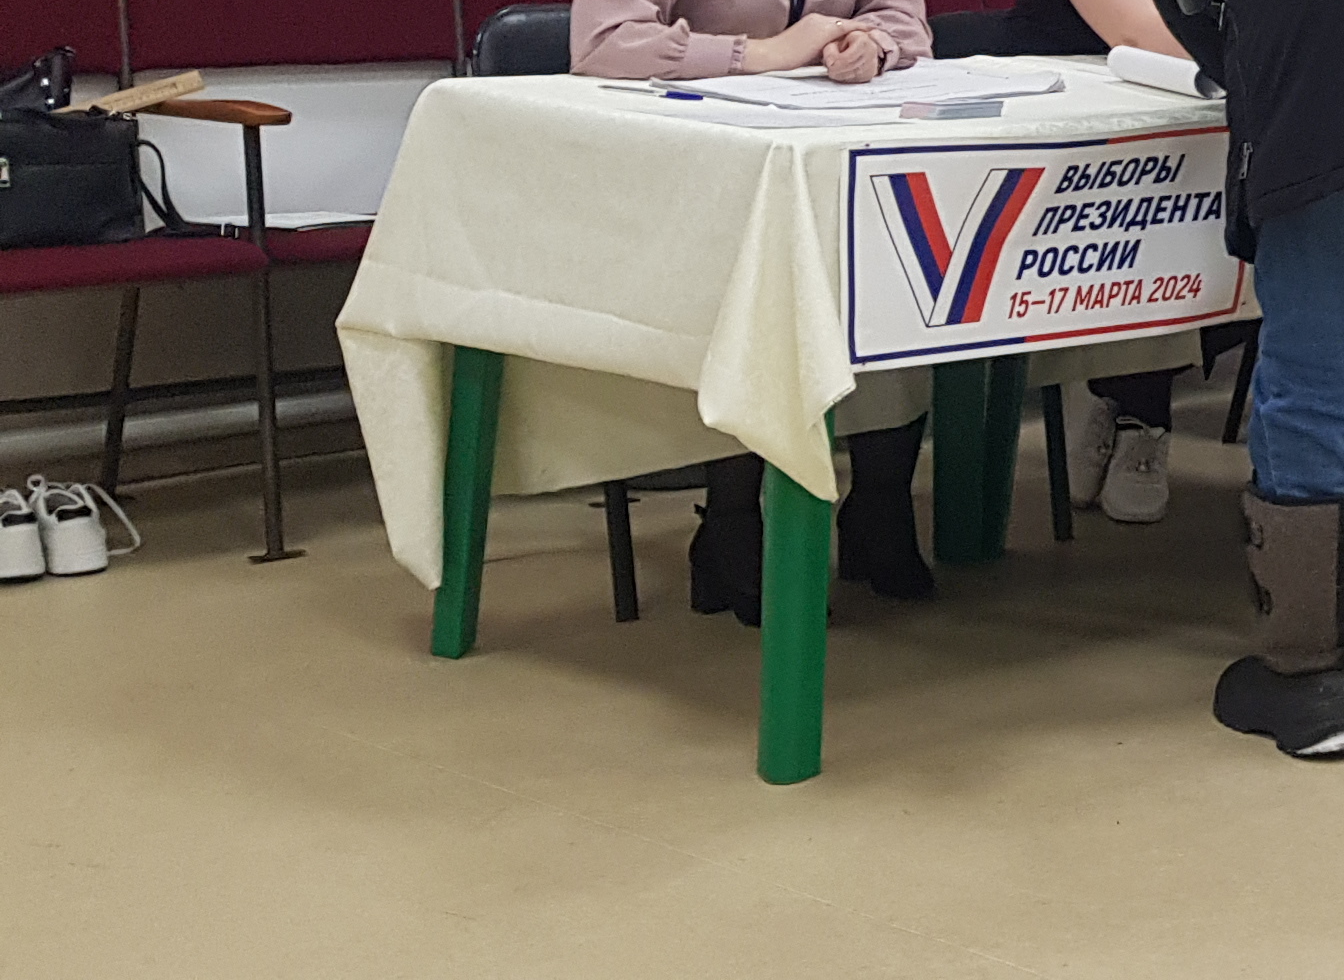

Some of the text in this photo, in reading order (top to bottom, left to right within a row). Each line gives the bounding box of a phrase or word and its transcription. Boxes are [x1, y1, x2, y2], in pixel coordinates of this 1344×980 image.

[1054, 154, 1186, 194] ВЫБОРЫ
[1032, 191, 1222, 236] ПРЕЗИДЕНТА
[1016, 239, 1142, 280] РОССИИ
[1072, 279, 1142, 312] МАРТА
[1148, 273, 1202, 303] 2024
